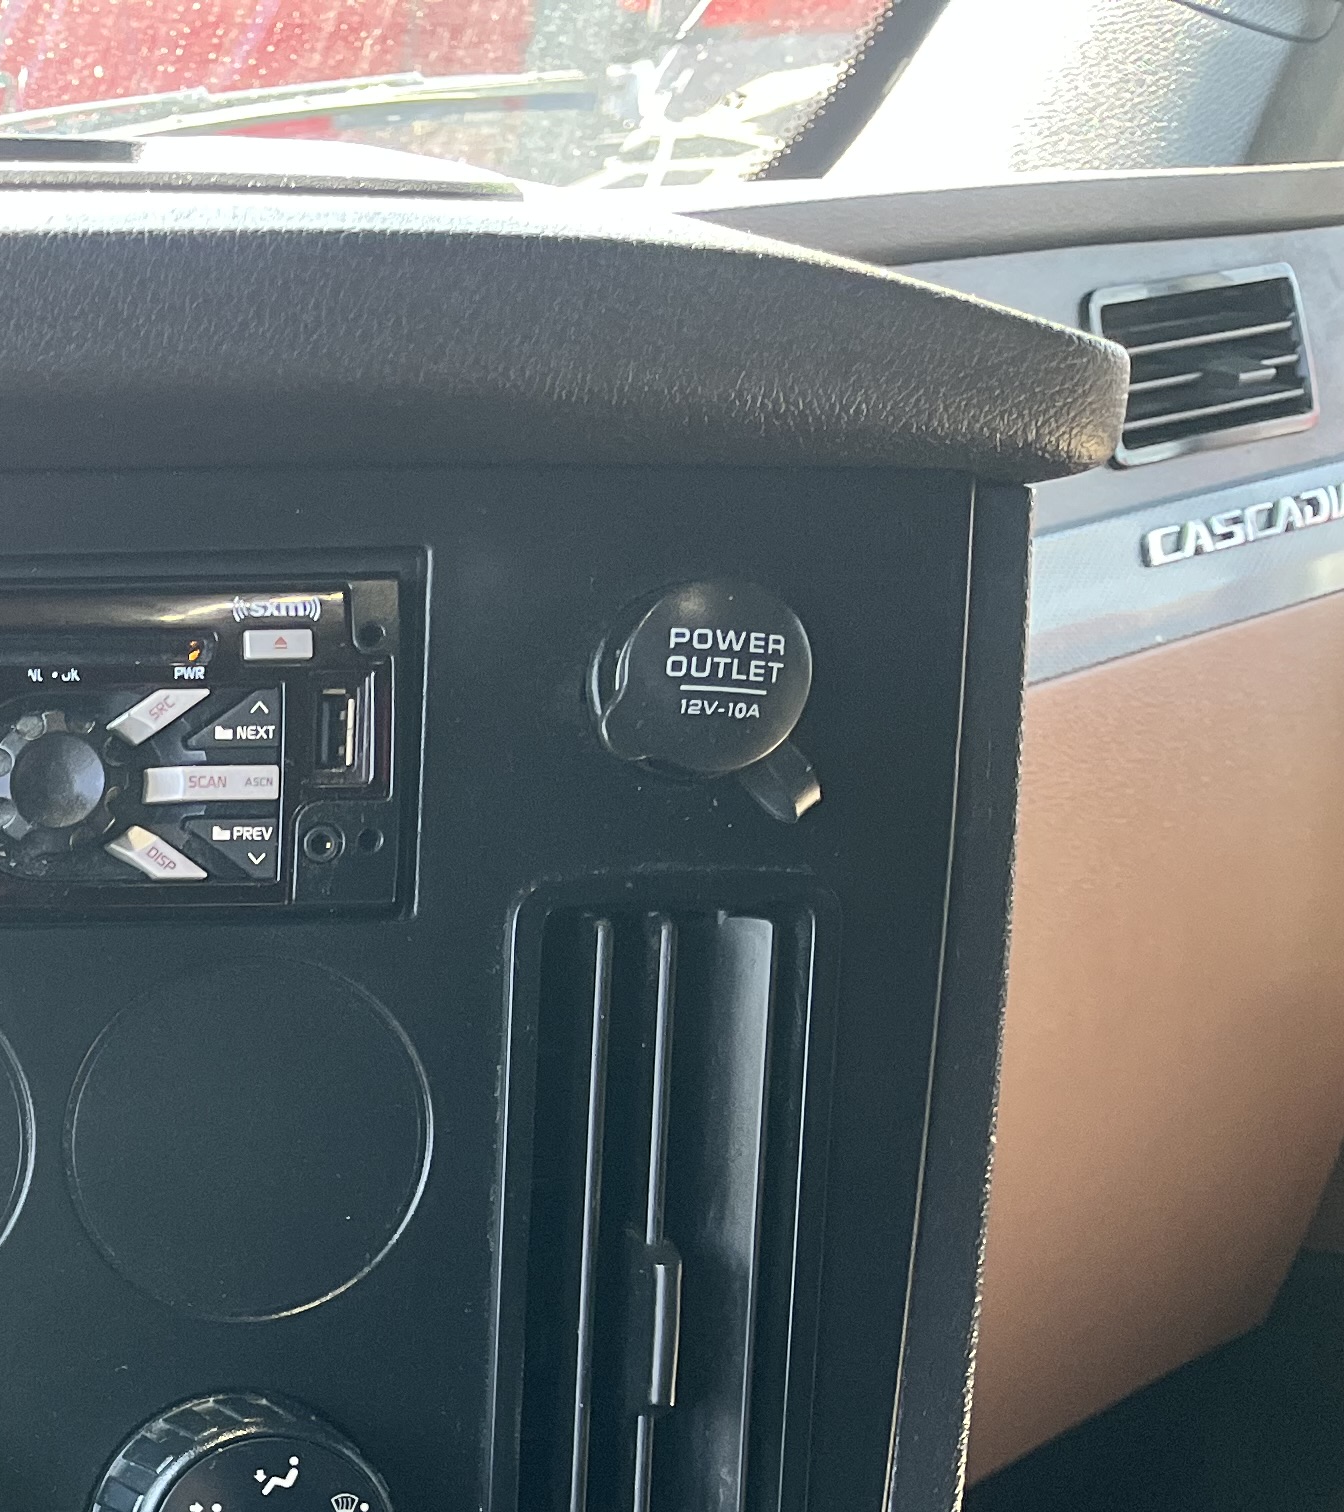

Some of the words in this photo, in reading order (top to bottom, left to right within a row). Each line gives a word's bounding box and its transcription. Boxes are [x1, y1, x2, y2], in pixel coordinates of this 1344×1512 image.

[669, 627, 785, 656] POWER
[173, 666, 206, 680] PWR
[665, 655, 785, 683] OUTLET
[148, 695, 176, 721] SRC
[680, 698, 760, 719] 12V-10A
[236, 725, 276, 740] NEXT
[188, 775, 228, 789] SCAN
[244, 776, 274, 787] ASCN
[232, 826, 274, 842] PREV
[146, 847, 177, 871] DISP
